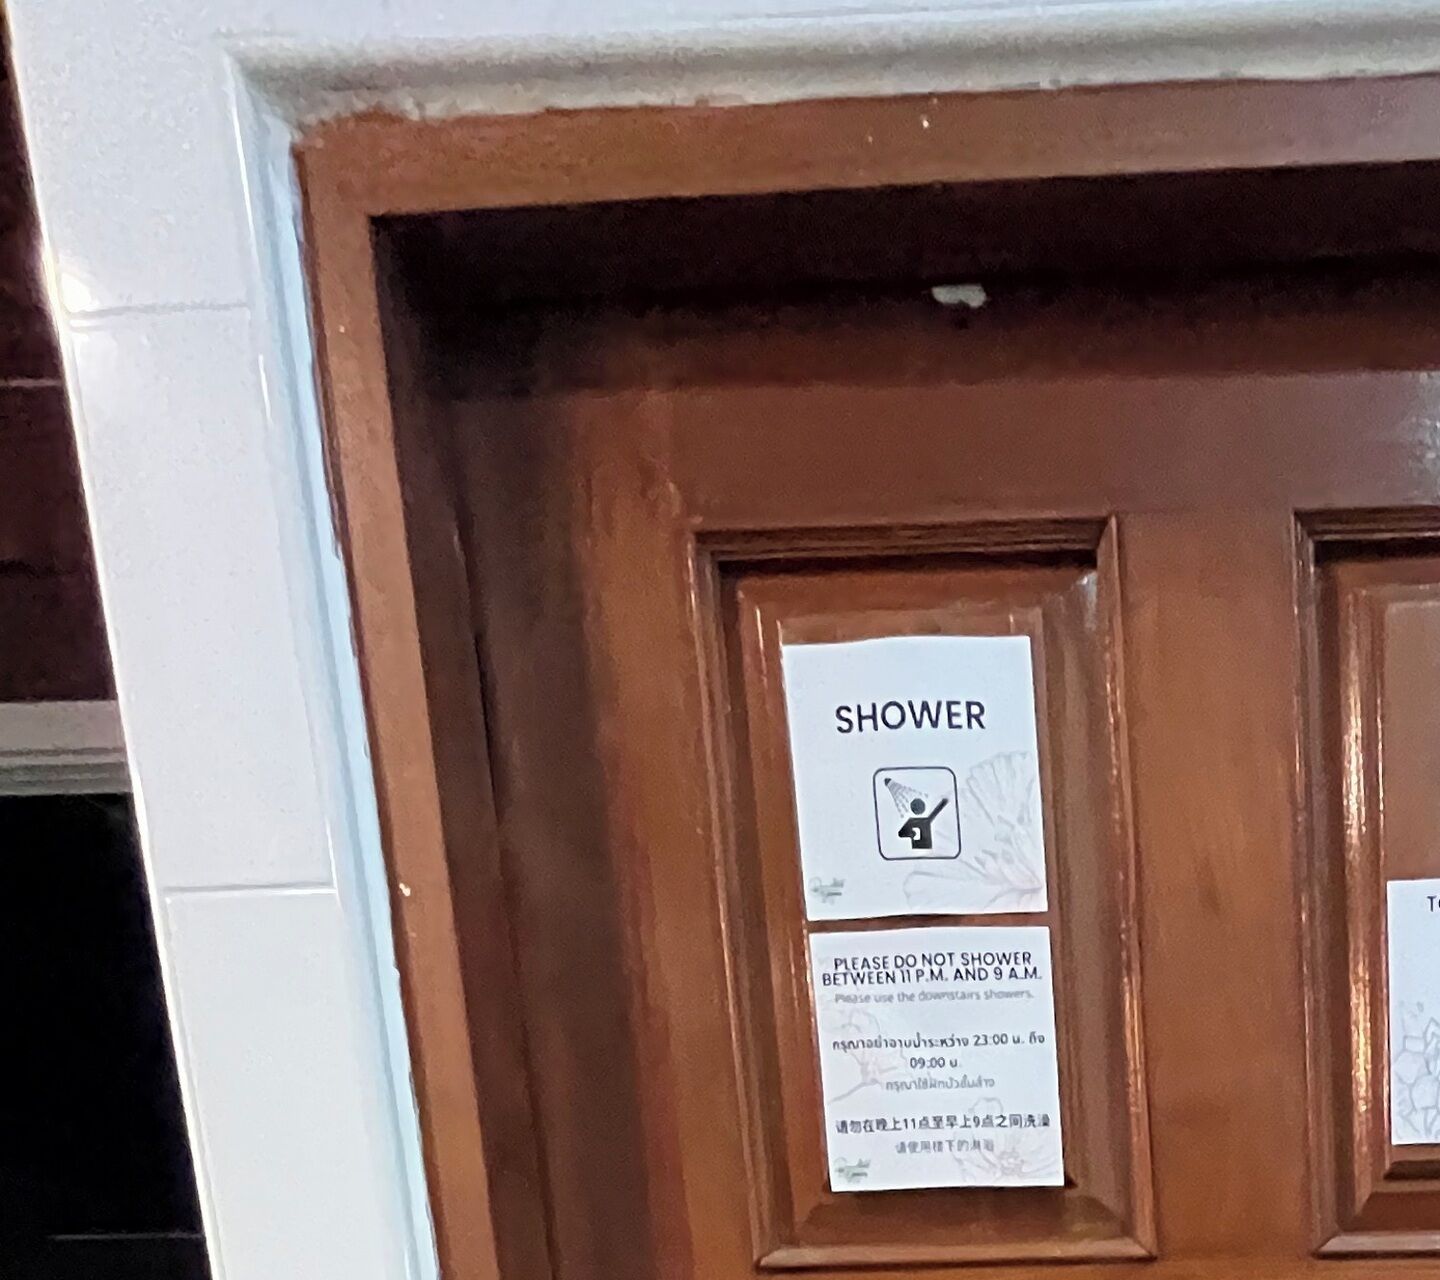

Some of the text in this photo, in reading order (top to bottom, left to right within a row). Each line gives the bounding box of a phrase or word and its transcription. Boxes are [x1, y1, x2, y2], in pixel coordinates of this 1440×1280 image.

[835, 700, 986, 734] SHOWER
[834, 951, 1032, 971] PLEASE DO NOT SHOWER
[822, 965, 1043, 987] BETWEEN 11 P.M. AND 9 A.M.
[834, 993, 871, 1004] Please
[873, 993, 894, 1003] use
[897, 991, 915, 1002] the
[918, 990, 981, 1001] downstairs
[973, 1033, 1009, 1046] 23:00
[909, 1056, 946, 1069] 09:00
